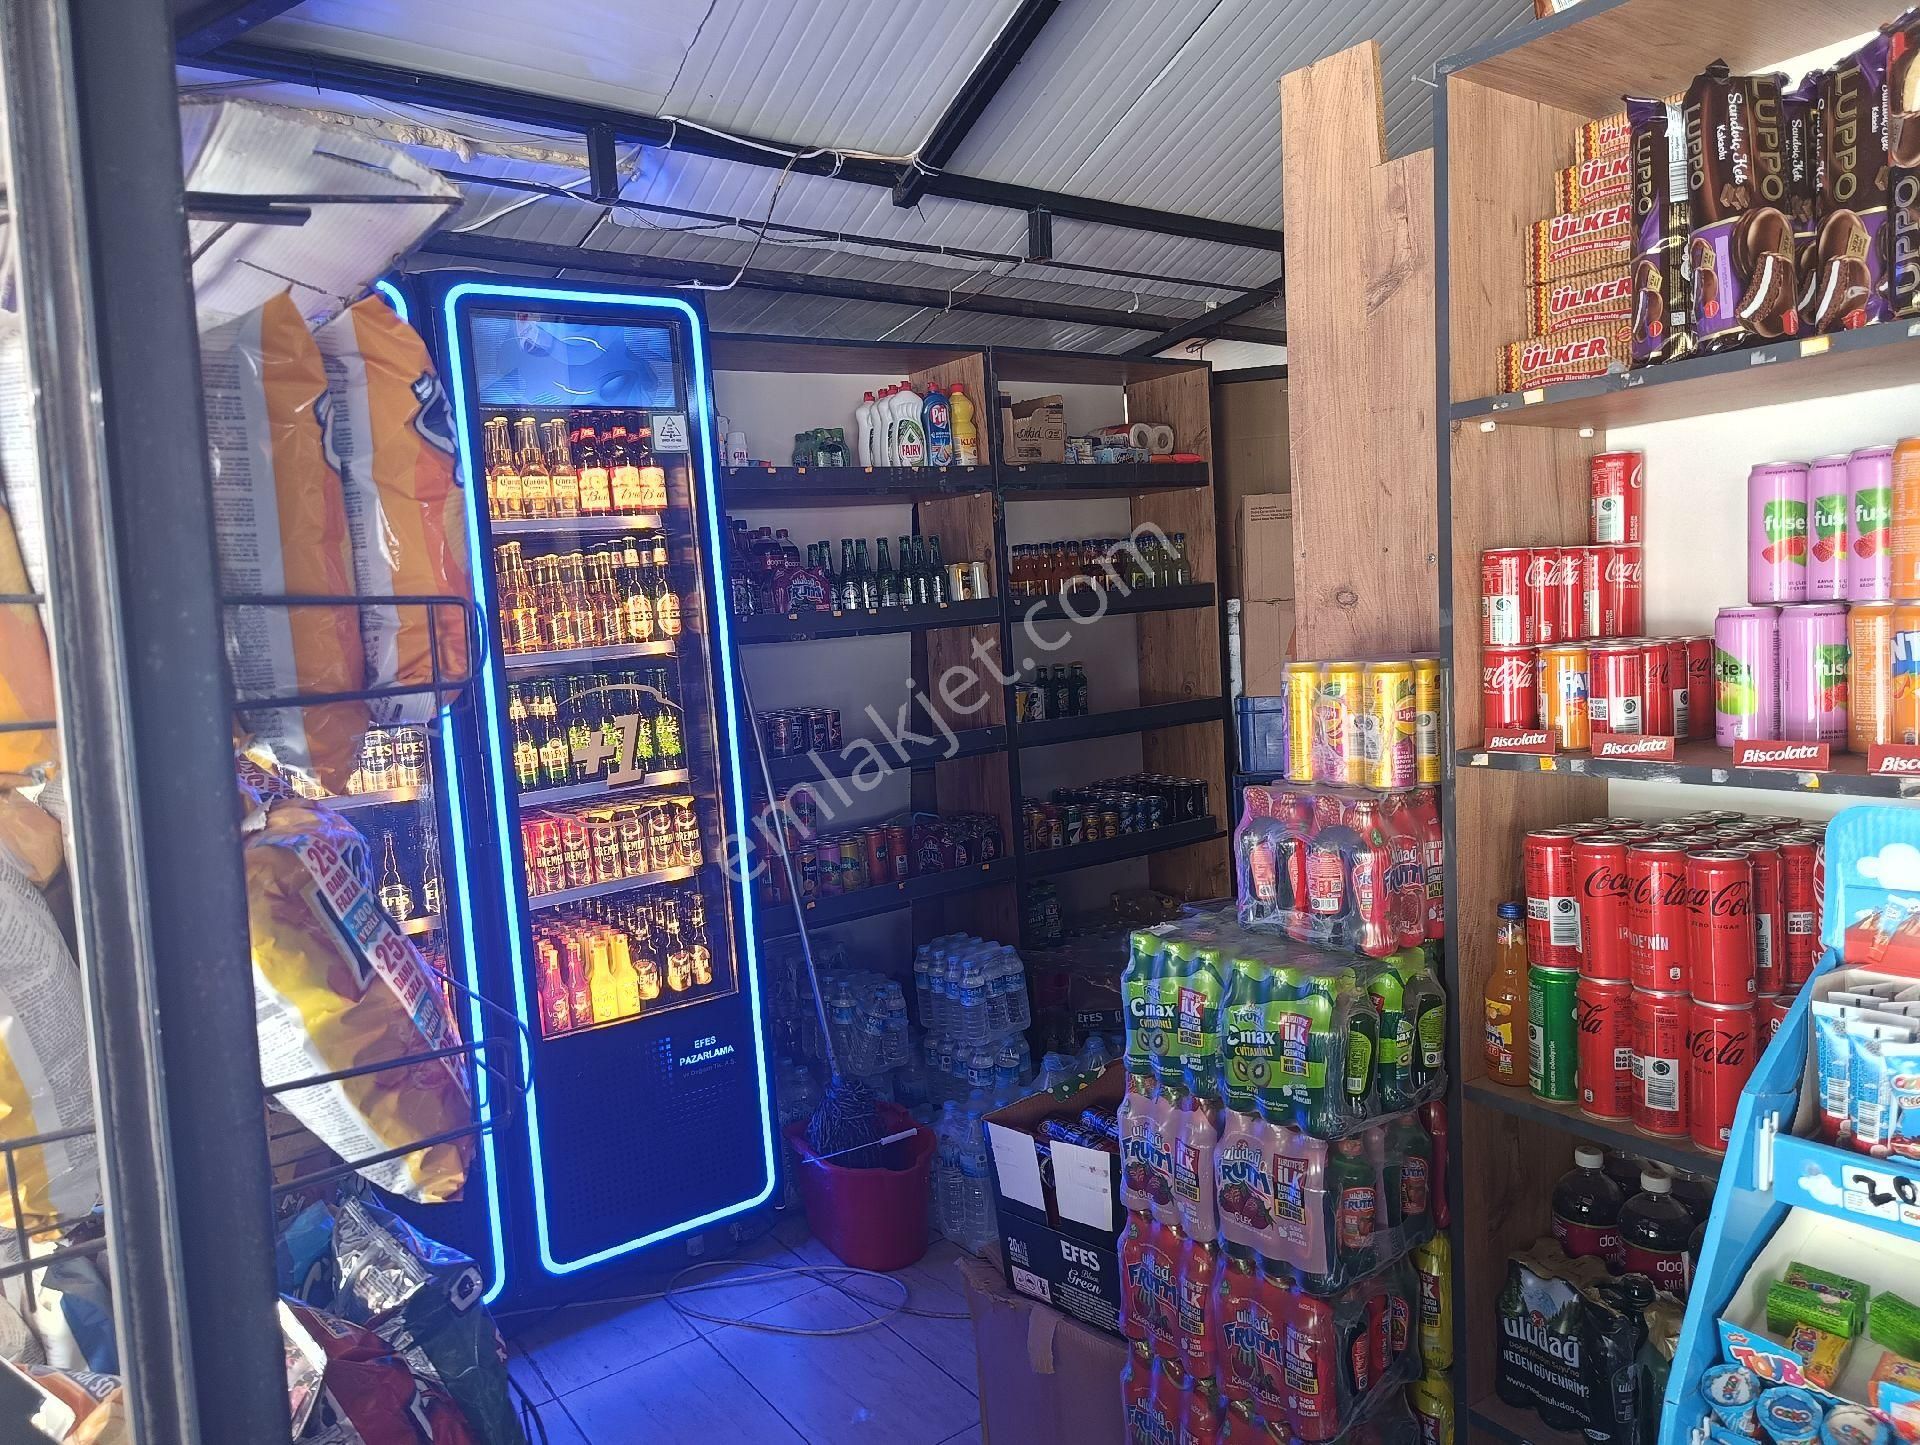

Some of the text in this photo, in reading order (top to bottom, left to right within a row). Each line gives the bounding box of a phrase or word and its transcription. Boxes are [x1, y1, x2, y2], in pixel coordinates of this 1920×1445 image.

[1752, 77, 1784, 201] LUPPO
[1834, 64, 1860, 203] LUPPO
[1684, 102, 1705, 191] LUPPO
[1579, 154, 1631, 189] ÜLK
[1637, 130, 1652, 215] LUPPO
[1550, 203, 1632, 244] ÜLKER
[1554, 249, 1570, 260] Petit
[1550, 276, 1632, 314] ÜLKER
[1554, 321, 1570, 330] Petit
[1520, 336, 1609, 373] ÜLKER
[1525, 380, 1541, 389] Petit
[932, 406, 947, 424] Pril
[902, 444, 921, 456] FAIRY
[1490, 732, 1548, 749] Biscolata
[1600, 739, 1667, 756] Biscolata
[1741, 745, 1820, 764] Biscolata
[326, 864, 350, 897] DAHA
[335, 879, 361, 914] FAZLA
[393, 960, 415, 992] DAHA
[403, 974, 425, 1009] FAZLA
[1077, 1012, 1103, 1023] EFES
[1129, 997, 1176, 1018] Cmax
[694, 1035, 717, 1049] EFES
[1227, 1023, 1276, 1046] Cmax
[1284, 1022, 1306, 1046] İLK
[679, 1044, 735, 1067] PAZARLAMA
[1223, 1146, 1262, 1167] uludağ
[1278, 1164, 1303, 1192] İLK
[1060, 1239, 1101, 1272] EFES
[1286, 1335, 1313, 1362] İLK
[1503, 1316, 1581, 1369] uludağ
[1503, 1349, 1534, 1373] NEDEN
